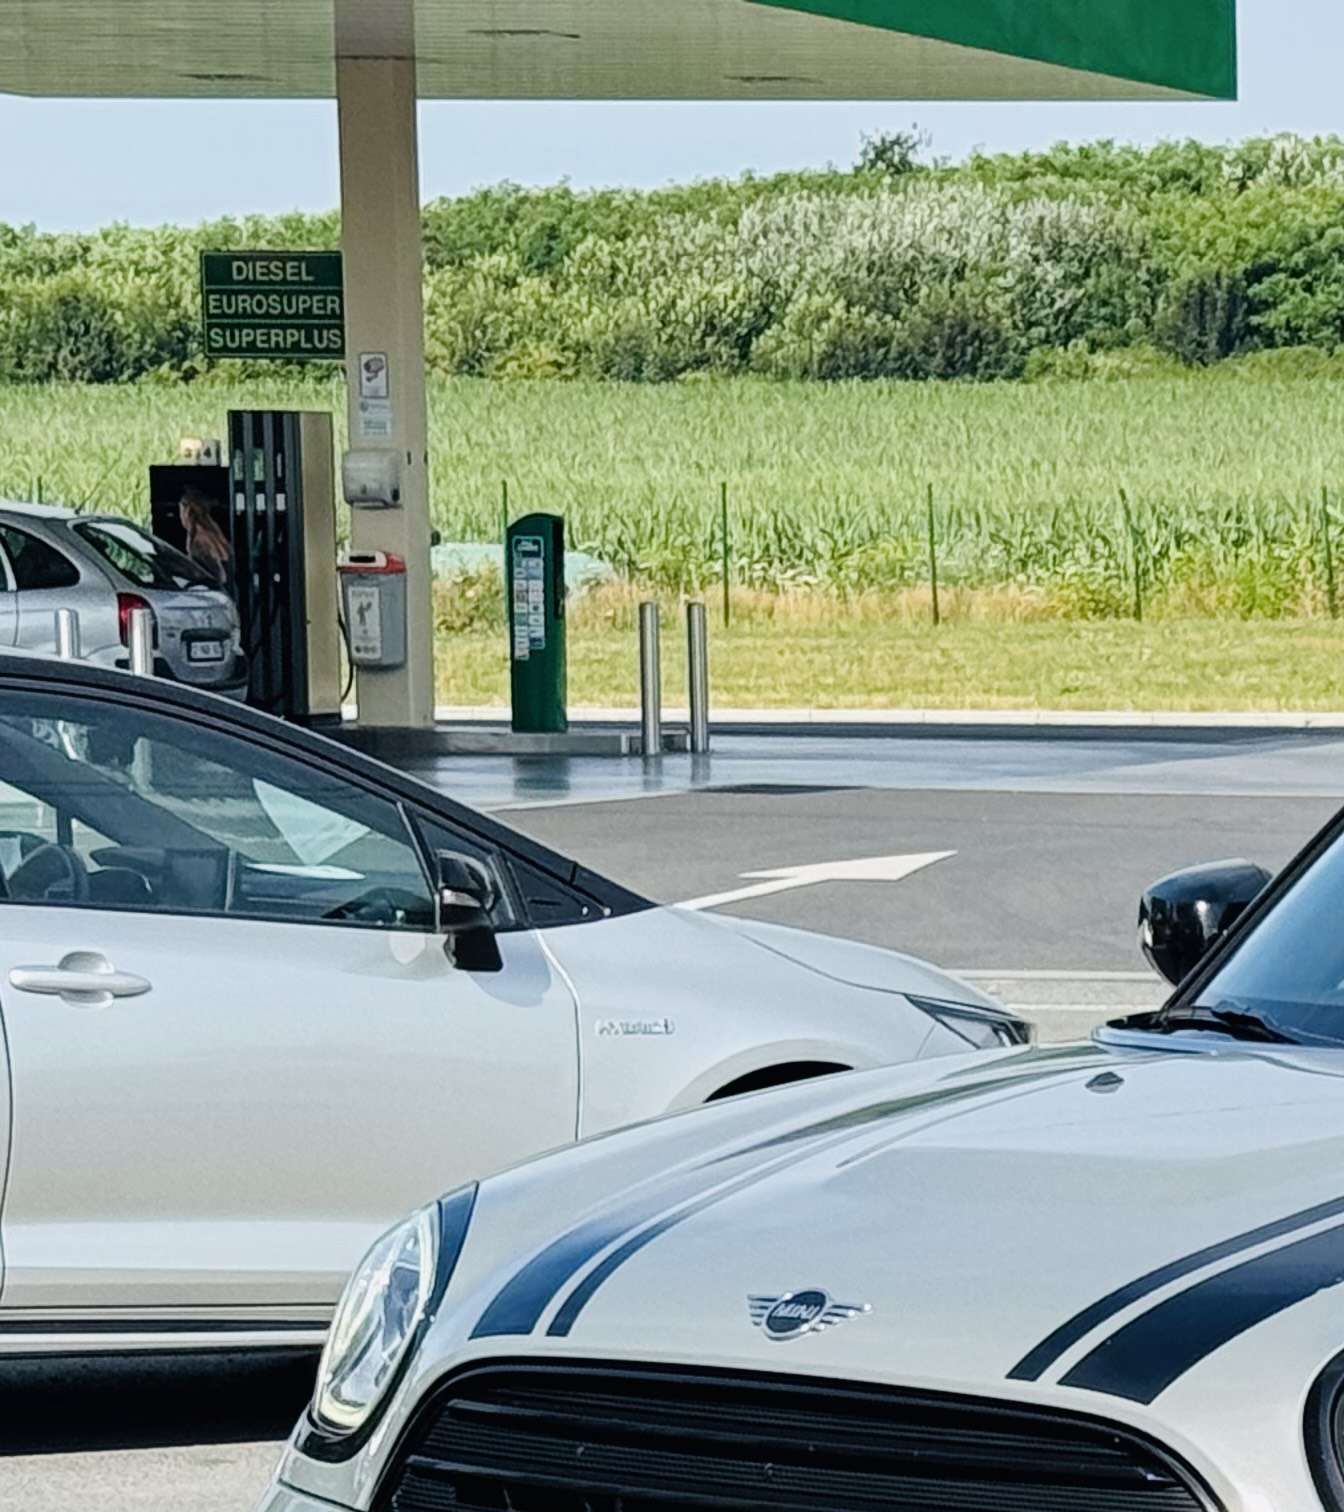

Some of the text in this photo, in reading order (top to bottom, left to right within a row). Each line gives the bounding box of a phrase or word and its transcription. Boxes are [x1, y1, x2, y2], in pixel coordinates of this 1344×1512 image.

[231, 261, 315, 281] DIESEL
[208, 294, 341, 315] EUROSUPER
[209, 327, 342, 348] SUPERPLUS
